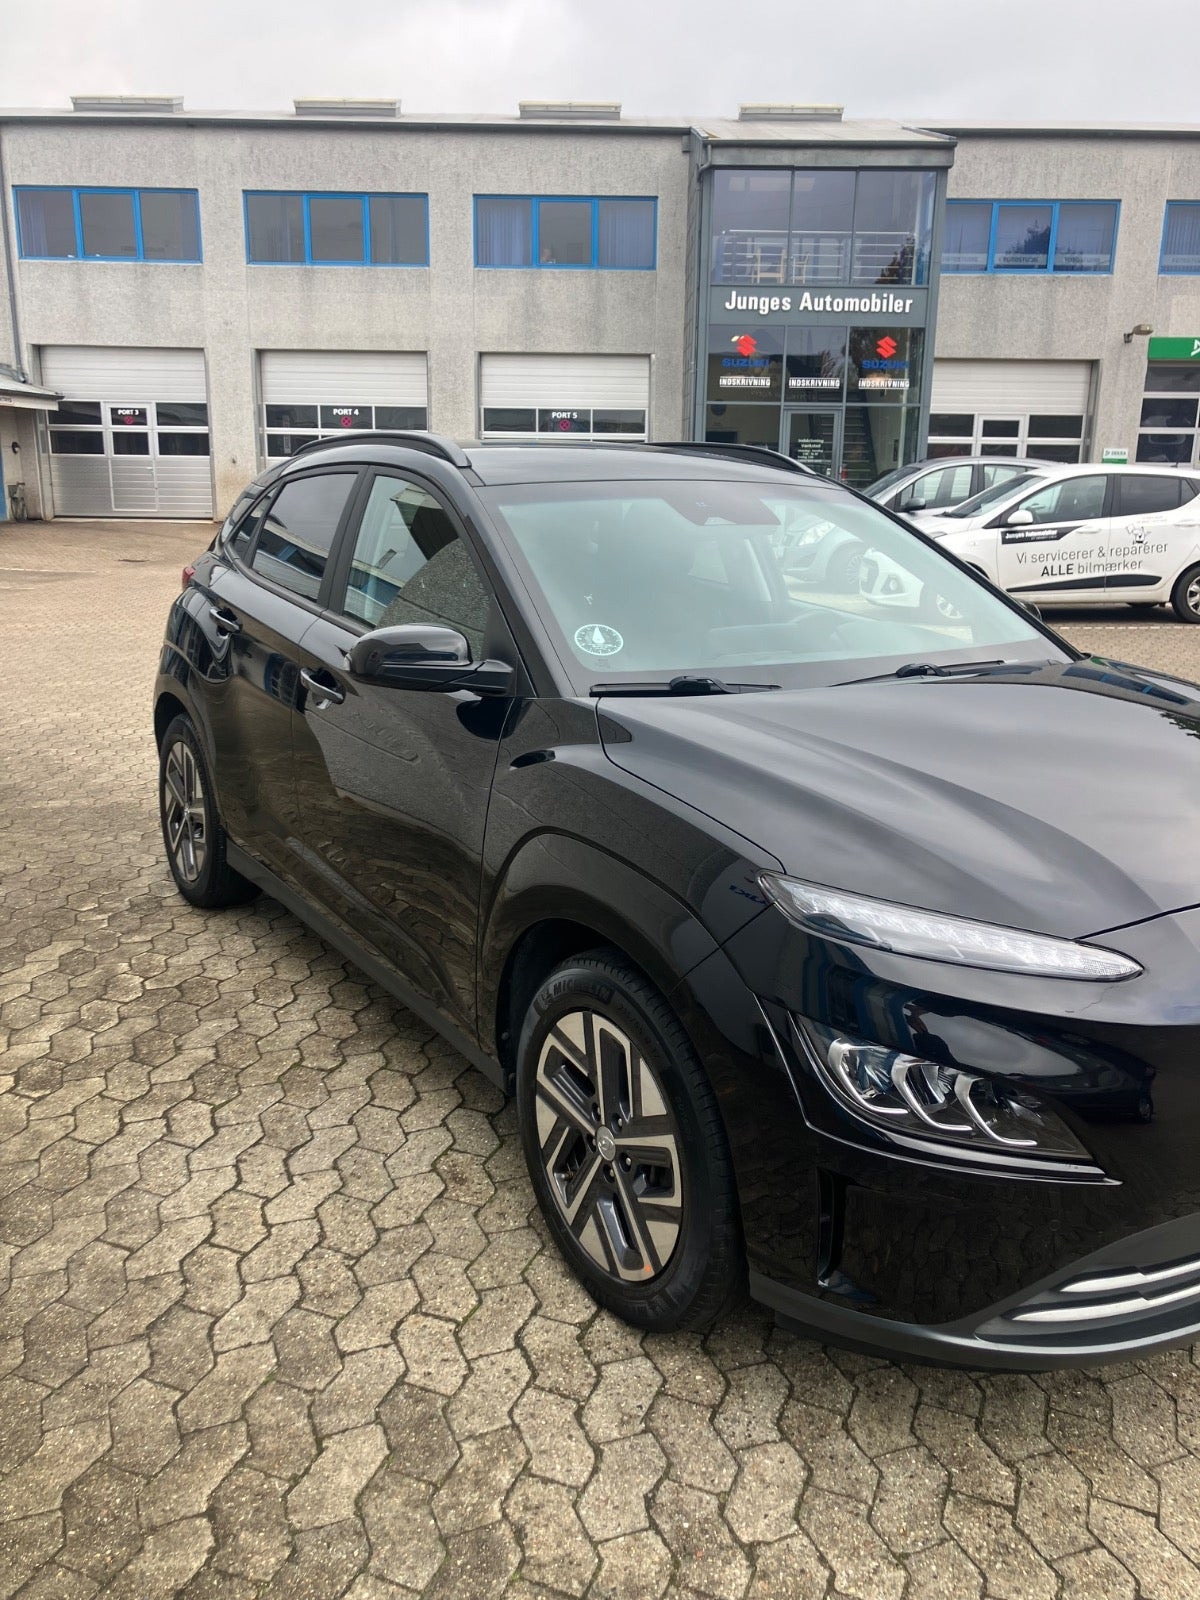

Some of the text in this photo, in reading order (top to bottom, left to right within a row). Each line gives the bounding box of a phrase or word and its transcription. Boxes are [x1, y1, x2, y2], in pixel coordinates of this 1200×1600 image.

[725, 291, 913, 315] Junges Automobiler
[722, 358, 769, 368] SUZUKI
[862, 360, 910, 369] SUZUKI
[719, 377, 771, 386] INDSKRIVNING
[789, 378, 840, 387] INDSKRIVNING
[858, 379, 910, 388] INDSKRIVNING
[551, 411, 578, 419] PORT 5
[1016, 552, 1027, 564] Vi
[1031, 549, 1094, 563] servicerer
[1097, 546, 1106, 558] &
[1041, 561, 1143, 577] ALLE bilmærker
